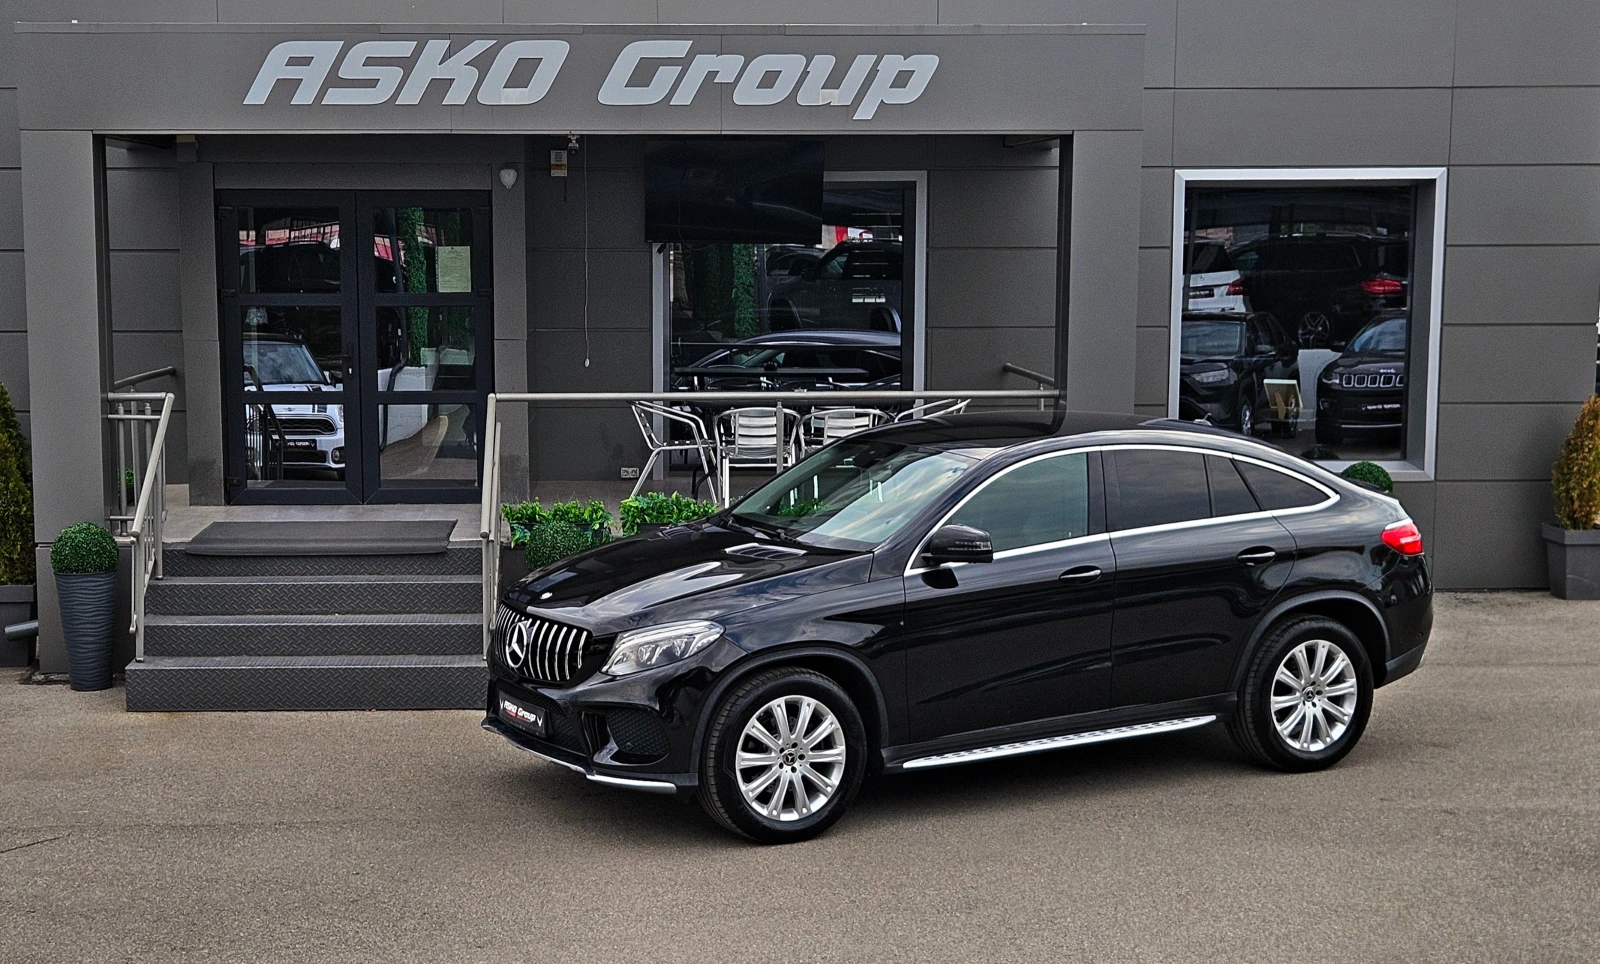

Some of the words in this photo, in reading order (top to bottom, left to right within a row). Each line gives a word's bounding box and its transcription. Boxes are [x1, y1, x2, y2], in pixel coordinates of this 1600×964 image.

[243, 40, 569, 106] ASKO
[597, 40, 940, 120] Group
[518, 708, 536, 722] Group
